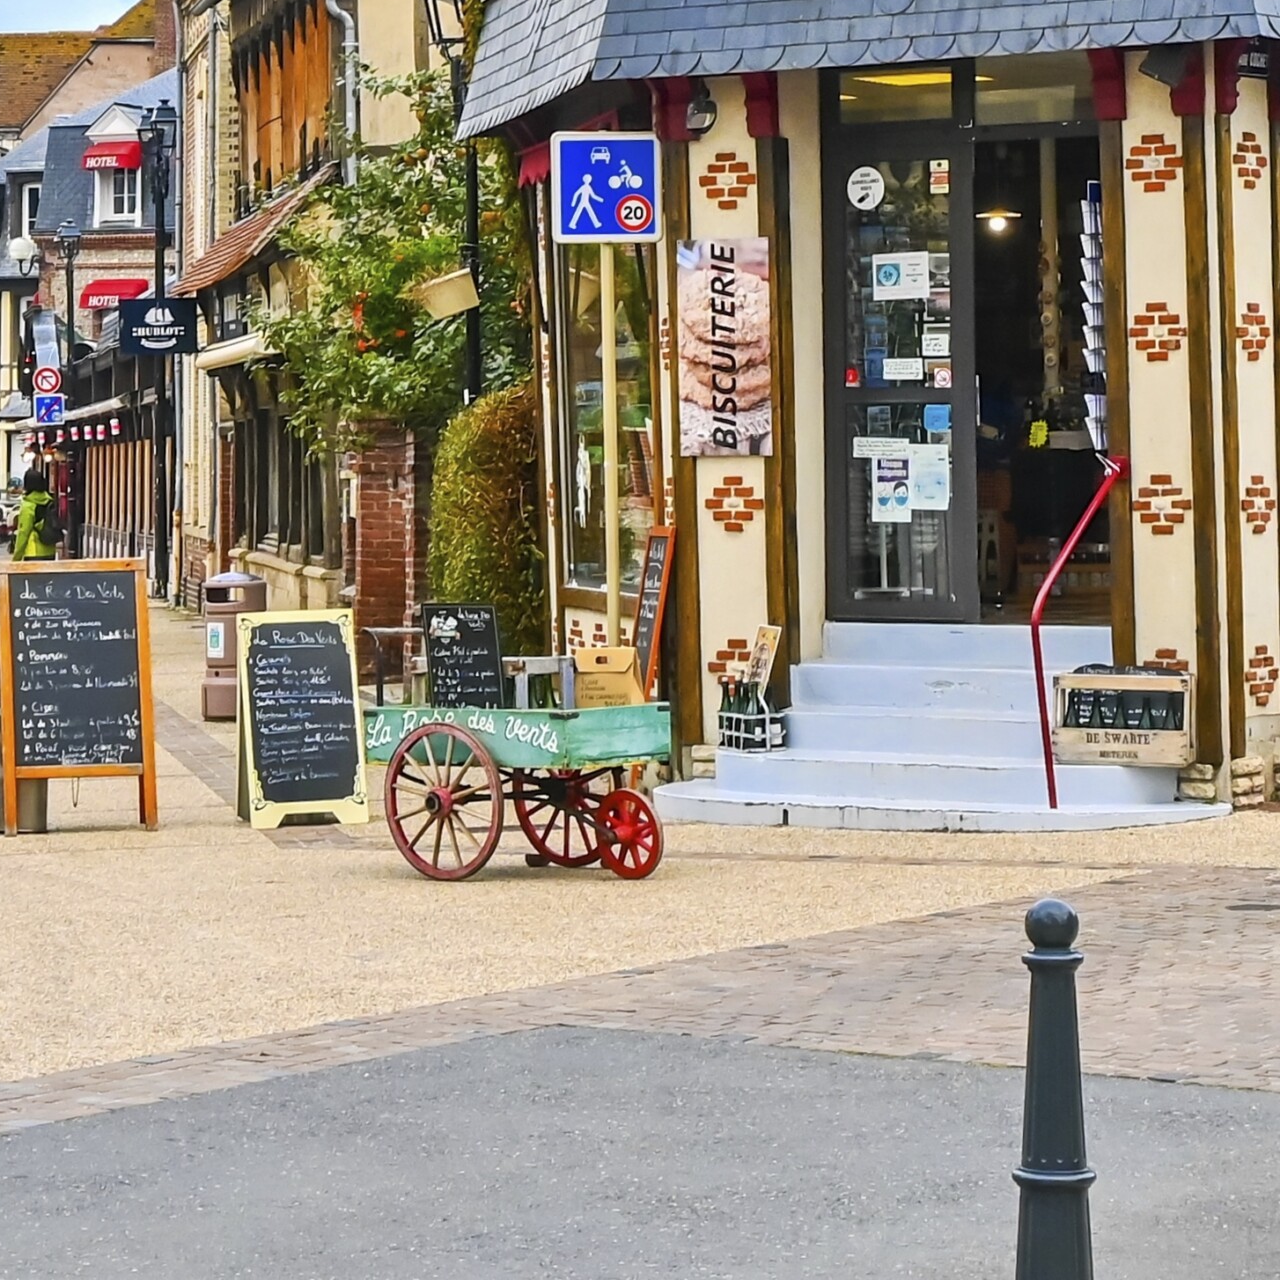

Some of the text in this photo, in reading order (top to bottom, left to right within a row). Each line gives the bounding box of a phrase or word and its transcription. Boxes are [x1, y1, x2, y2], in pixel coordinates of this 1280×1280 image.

[86, 156, 119, 168] HOTEL
[623, 205, 644, 220] 20
[88, 295, 119, 307] HOTEL
[710, 242, 738, 451] BISCUITERIE
[366, 713, 393, 749] La
[398, 710, 456, 740] Rose
[468, 711, 496, 734] des
[505, 716, 560, 754] Vents
[1086, 731, 1151, 745] DE SWARTE
